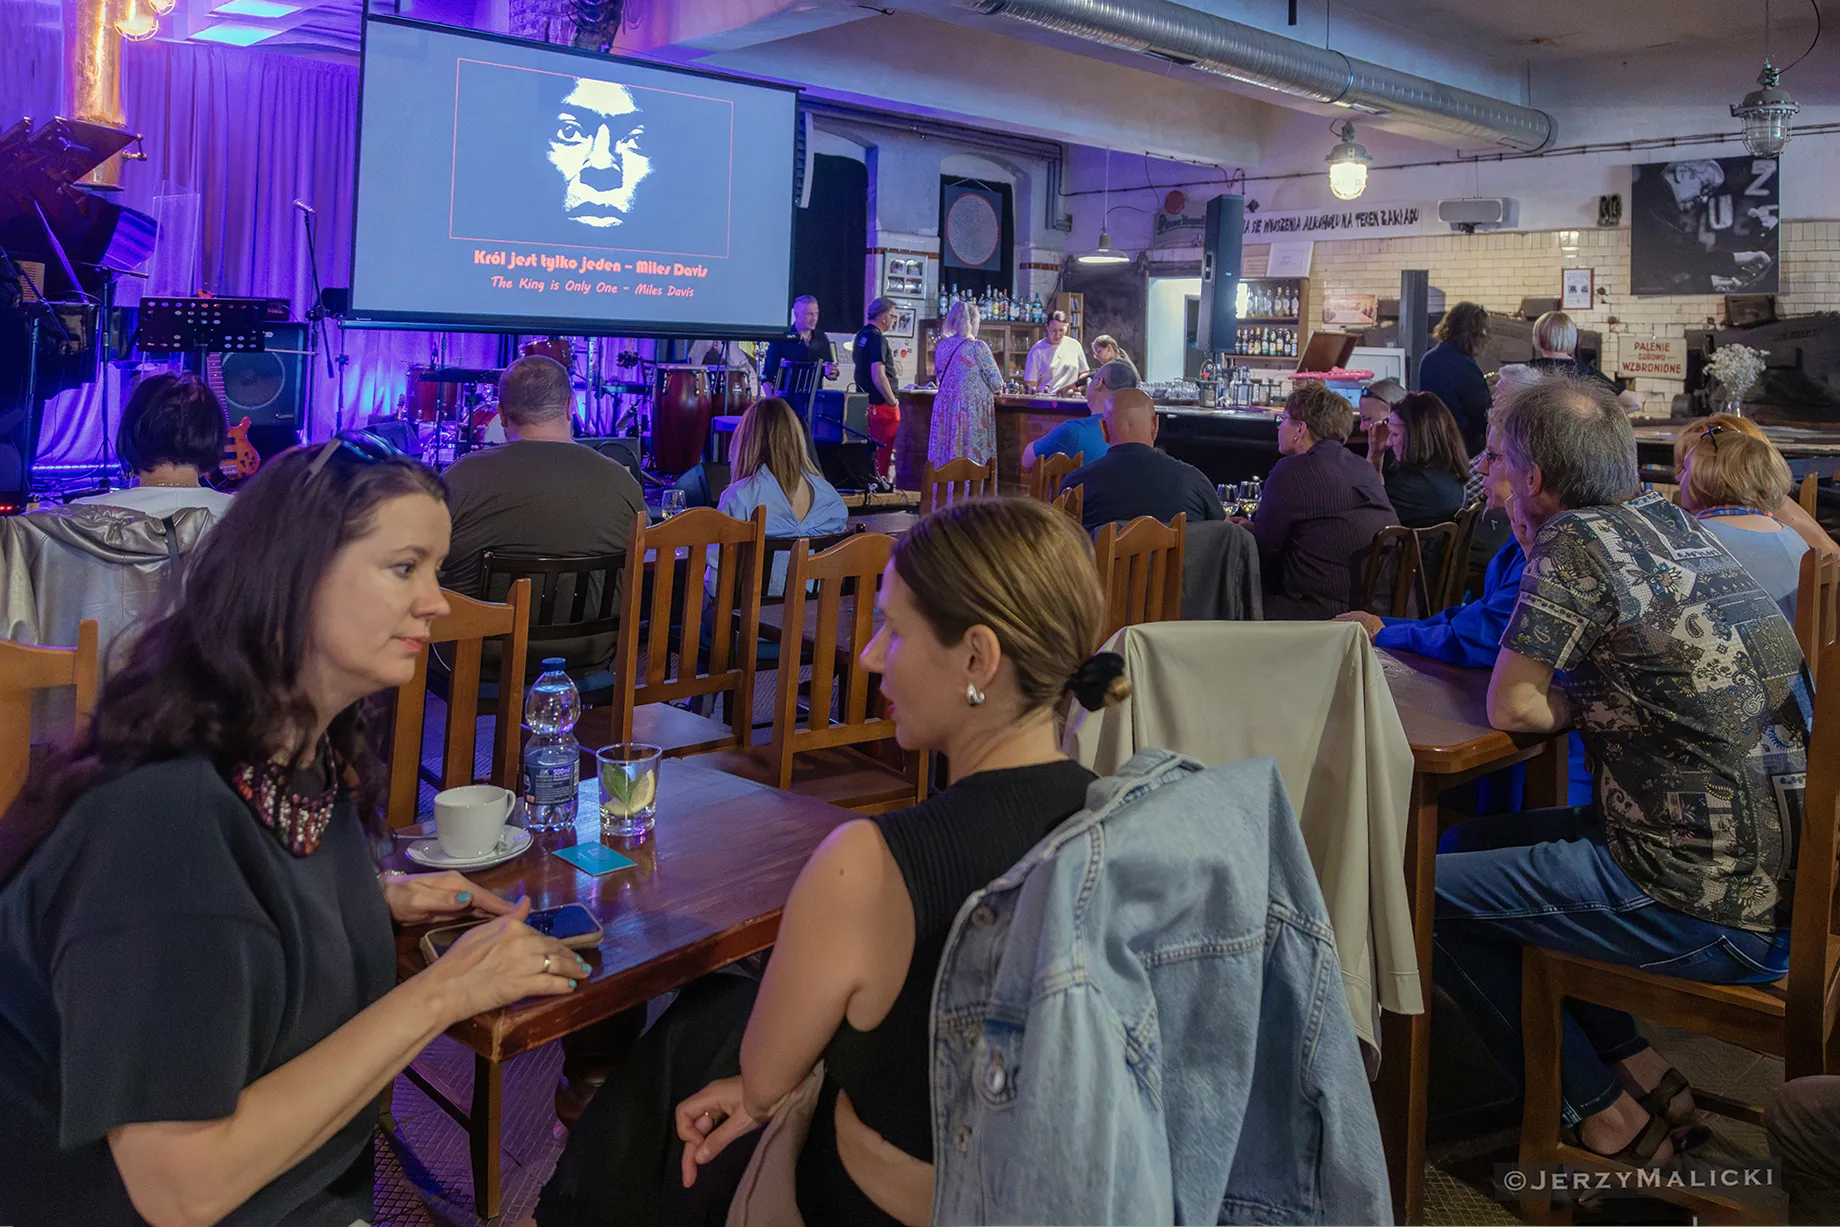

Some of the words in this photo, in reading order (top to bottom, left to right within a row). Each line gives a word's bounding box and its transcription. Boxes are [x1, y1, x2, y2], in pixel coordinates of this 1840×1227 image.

[1341, 211, 1354, 229] NA
[1355, 209, 1380, 228] TEREN
[473, 249, 506, 265] Król
[507, 251, 538, 270] jest
[540, 254, 578, 272] tylko
[578, 256, 622, 274] jeden
[636, 260, 671, 275] Miles
[673, 263, 708, 278] Davis
[491, 275, 513, 289] The
[519, 278, 545, 293] King
[549, 280, 560, 291] is
[564, 280, 591, 294] Only
[596, 281, 618, 294] One
[634, 283, 662, 296] Miles
[667, 285, 695, 298] Davis
[1633, 341, 1671, 352] PALENIE
[1622, 361, 1681, 374] WZBRONIONE
